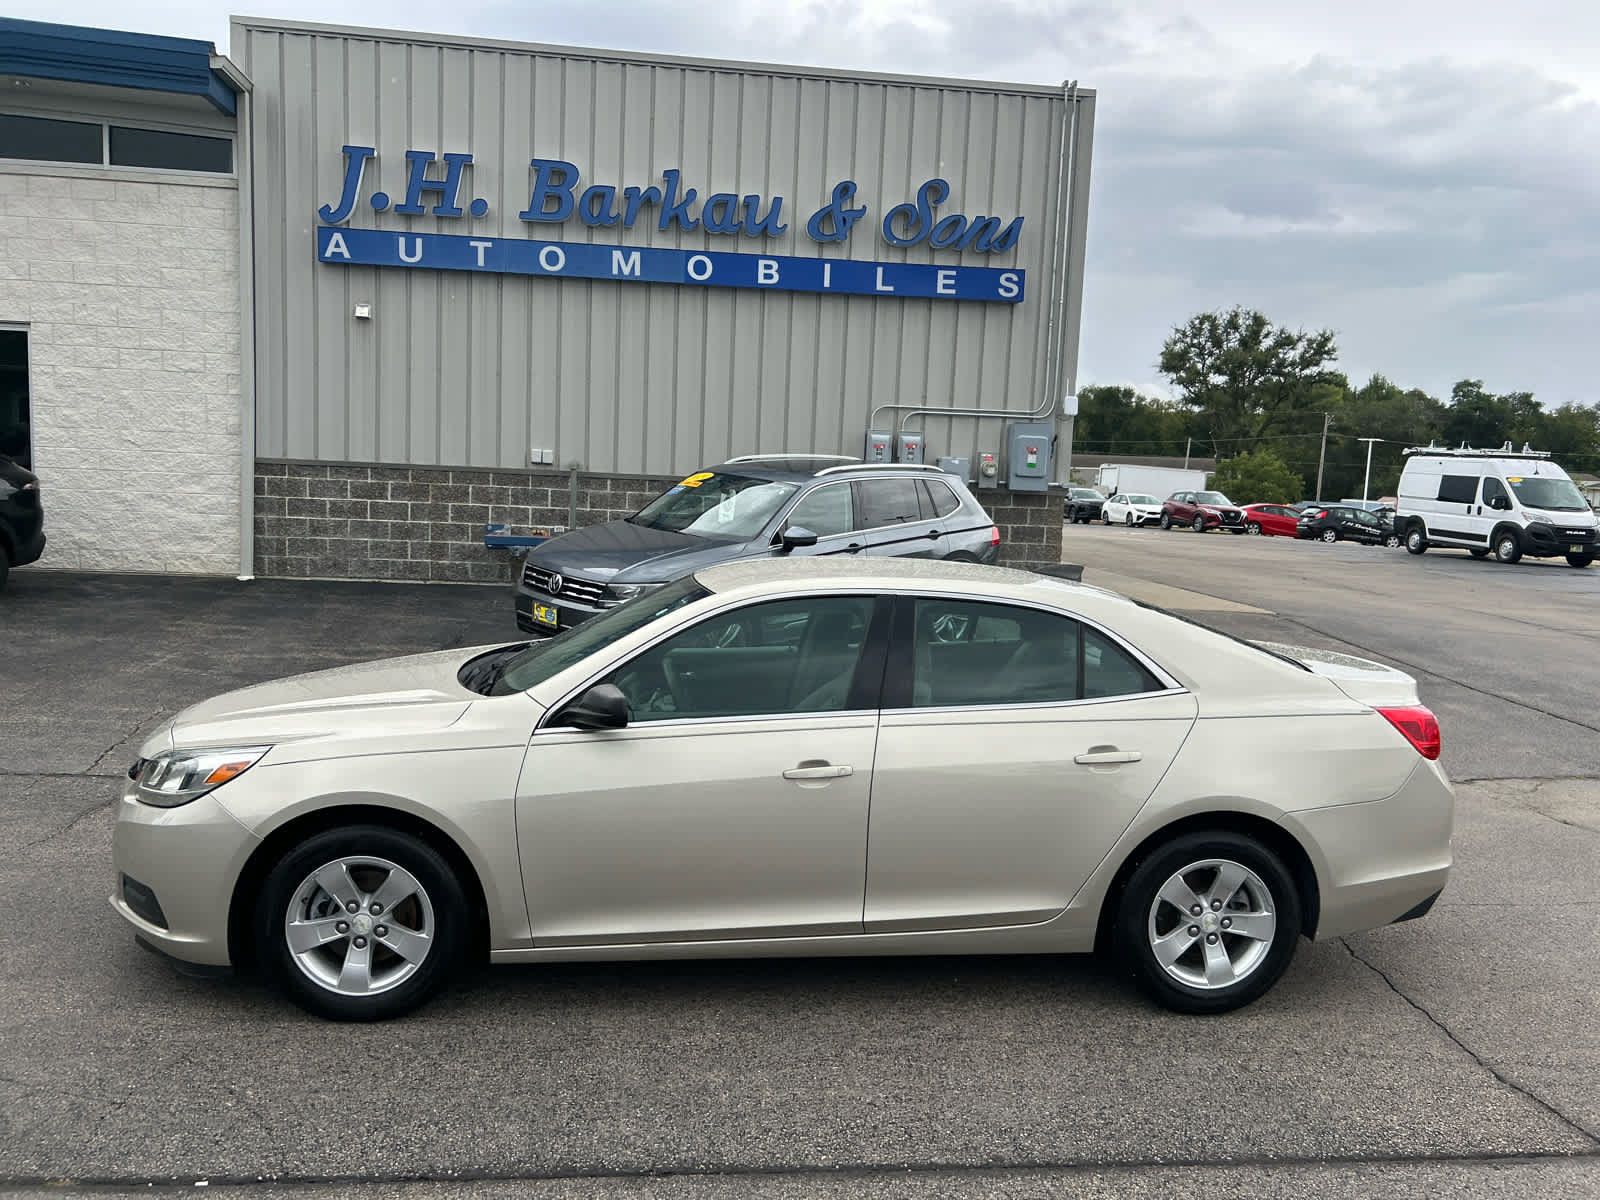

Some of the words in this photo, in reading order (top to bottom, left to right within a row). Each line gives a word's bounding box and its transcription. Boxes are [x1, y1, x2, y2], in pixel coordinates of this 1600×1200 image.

[318, 144, 489, 225] J.H.
[518, 157, 788, 239] Barkau
[806, 179, 867, 243] &
[882, 177, 1025, 253] Sons
[324, 231, 1020, 299] AUTOMOBILES
